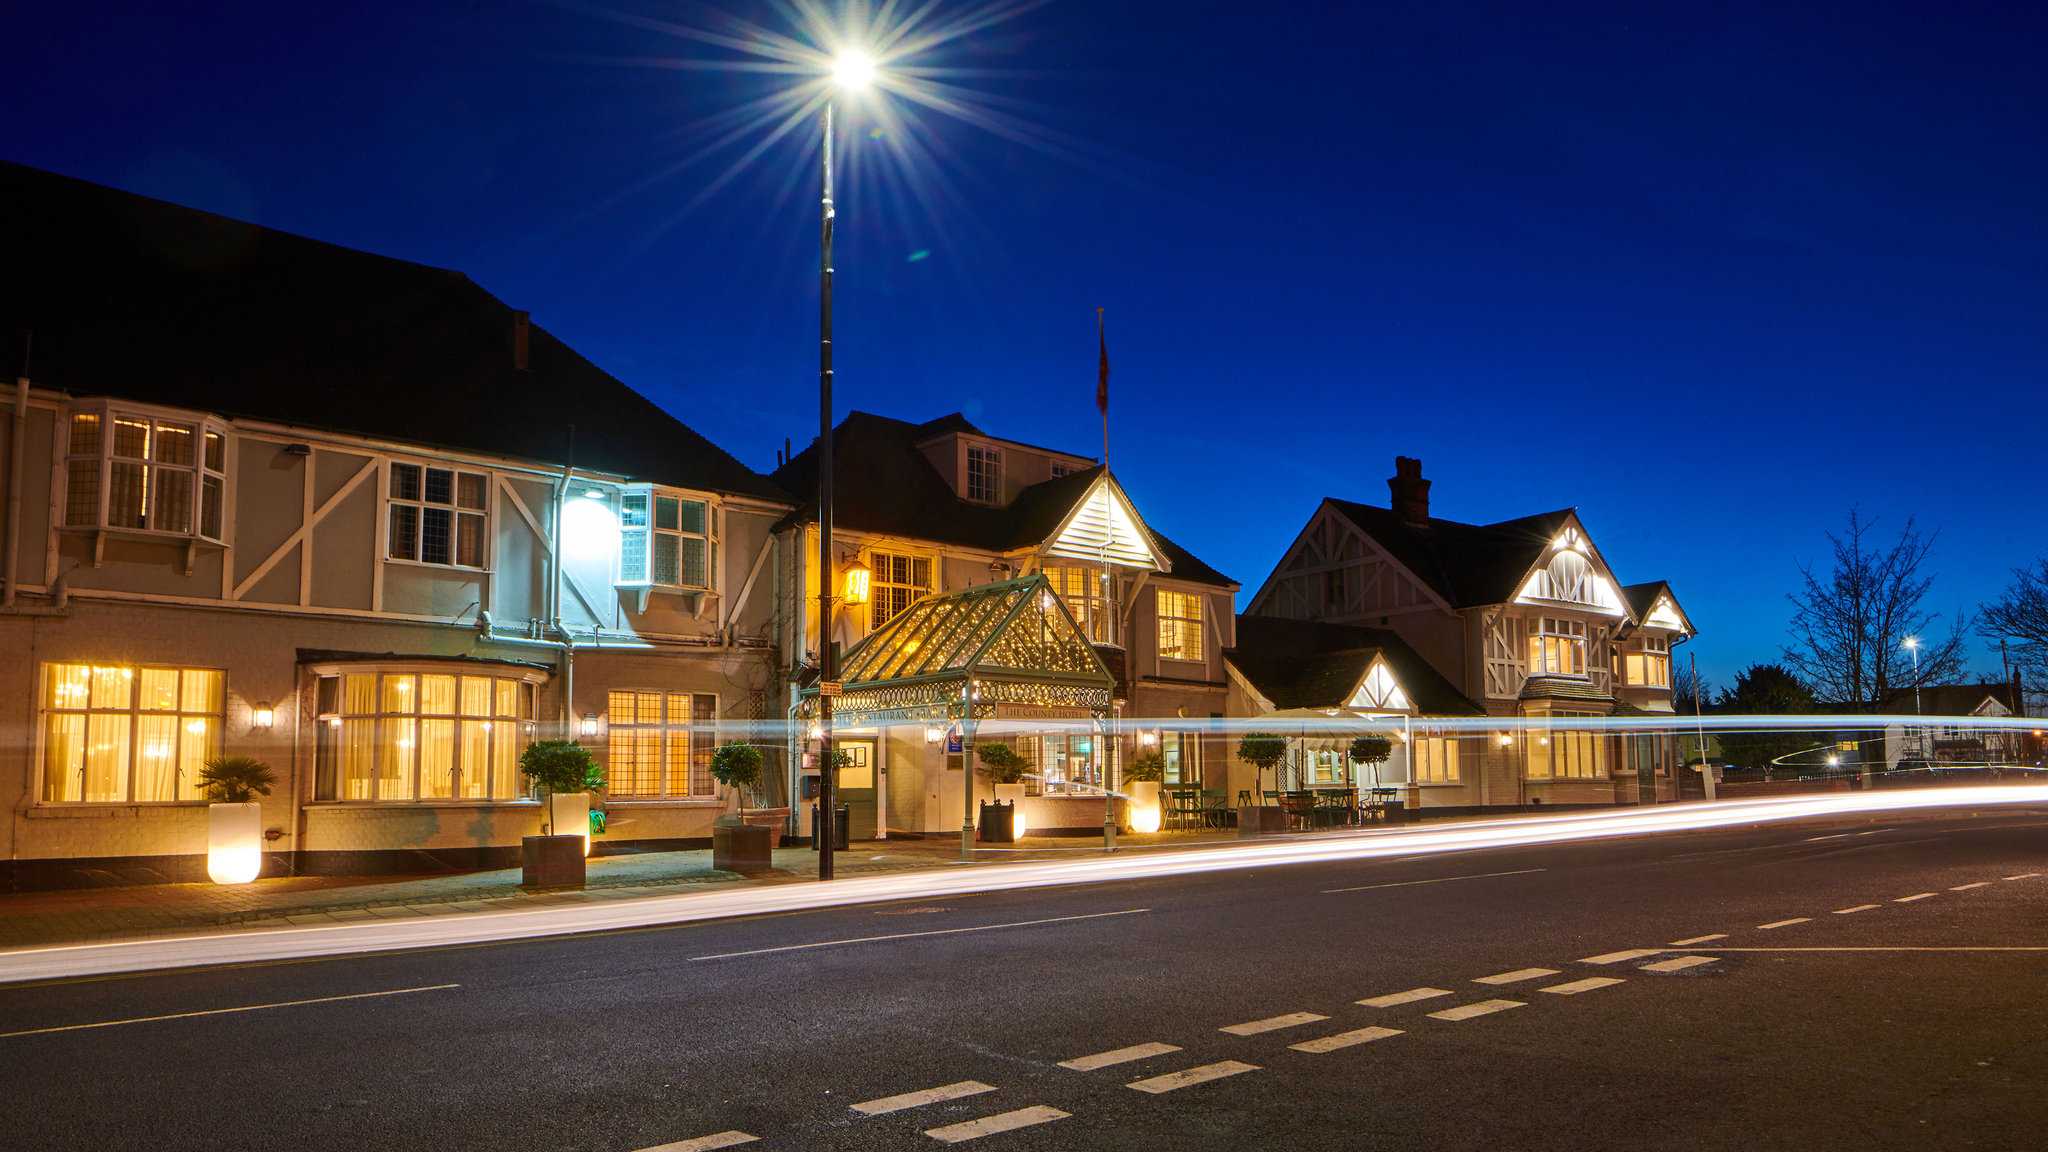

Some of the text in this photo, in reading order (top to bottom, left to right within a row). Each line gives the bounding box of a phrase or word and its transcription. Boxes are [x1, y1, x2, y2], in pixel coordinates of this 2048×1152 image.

[856, 708, 914, 723] STAURANT
[1006, 707, 1083, 719] THE COUNTY HOTEL
